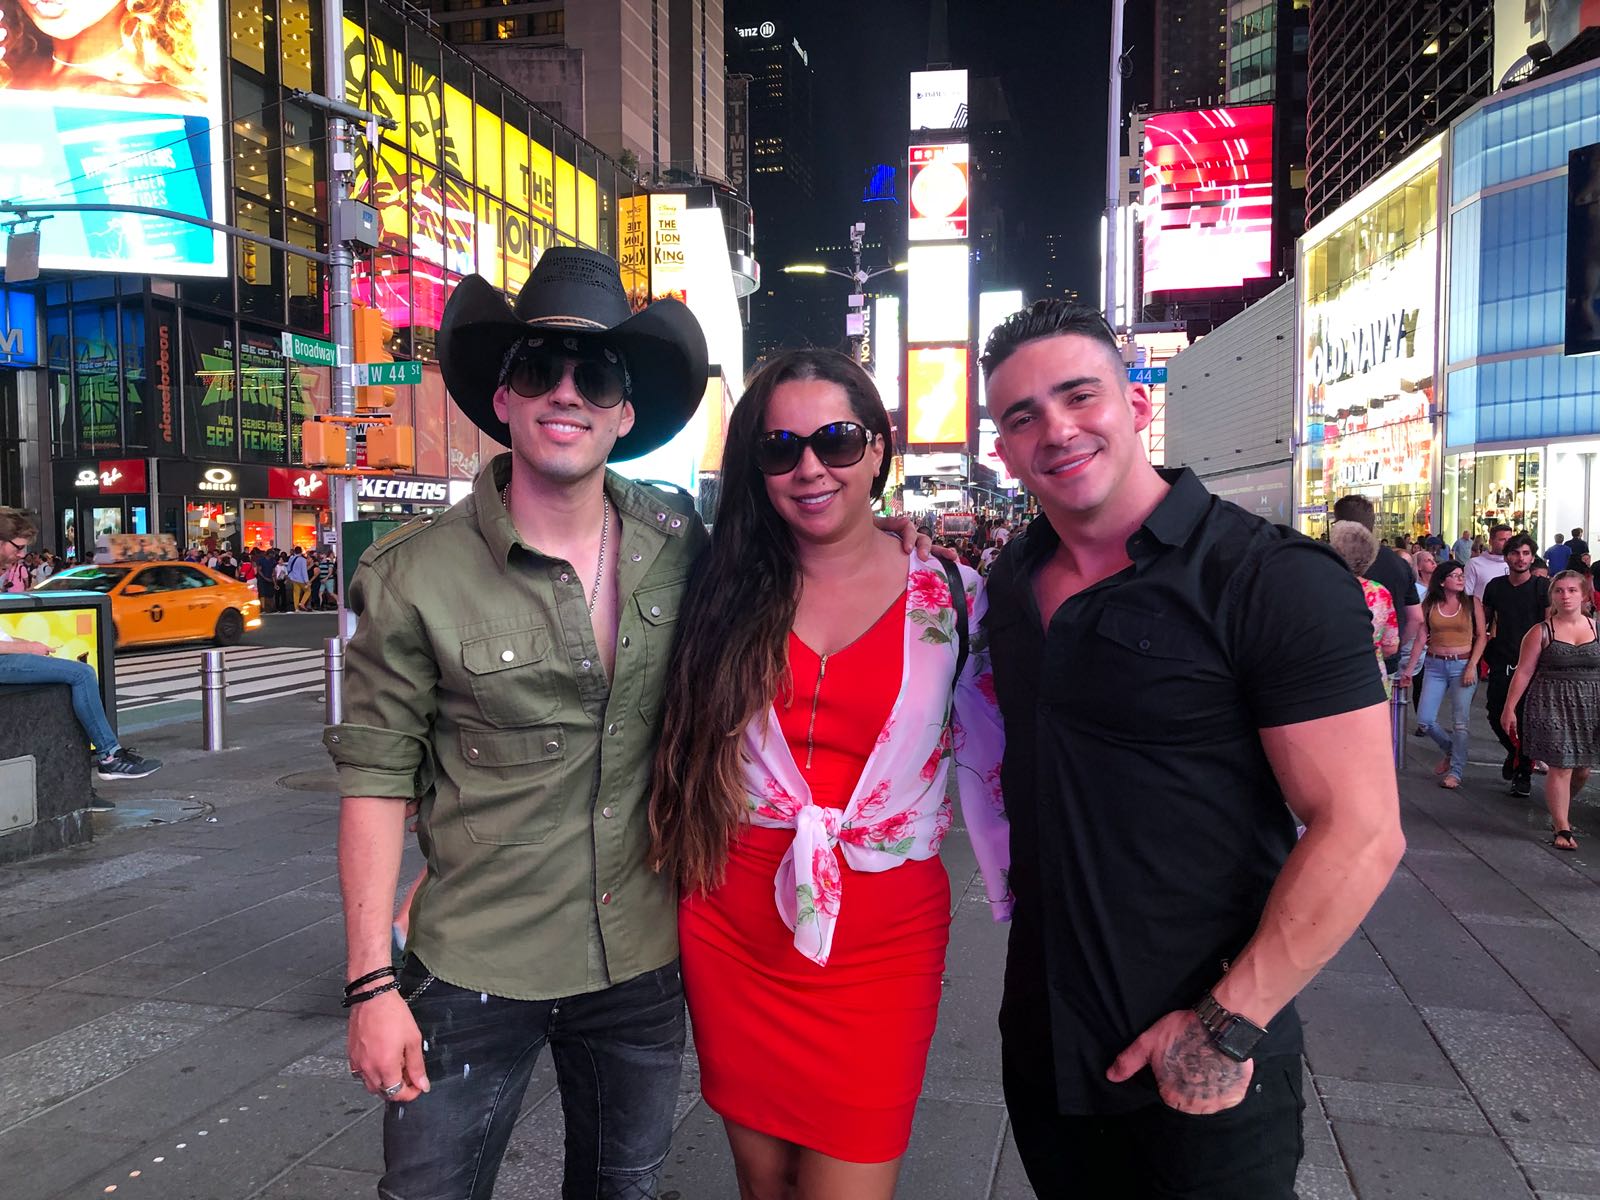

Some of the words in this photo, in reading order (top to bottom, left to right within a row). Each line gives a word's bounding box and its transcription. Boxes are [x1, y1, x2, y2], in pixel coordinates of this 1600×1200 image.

[735, 27, 758, 37] anz
[729, 101, 745, 184] TIMES
[520, 163, 552, 209] THE
[659, 220, 677, 229] THE
[656, 231, 680, 245] LION
[655, 247, 684, 264] KING
[224, 340, 256, 354] RSE
[294, 338, 335, 366] Broadway
[371, 366, 382, 382] W
[389, 365, 405, 381] 44
[411, 366, 420, 375] St
[1135, 369, 1152, 382] 44
[157, 325, 173, 442] nickelodeon
[218, 416, 232, 424] NEW
[242, 418, 265, 429] SERIES
[199, 482, 237, 491] OAKLEY
[359, 479, 447, 500] KECHERS
